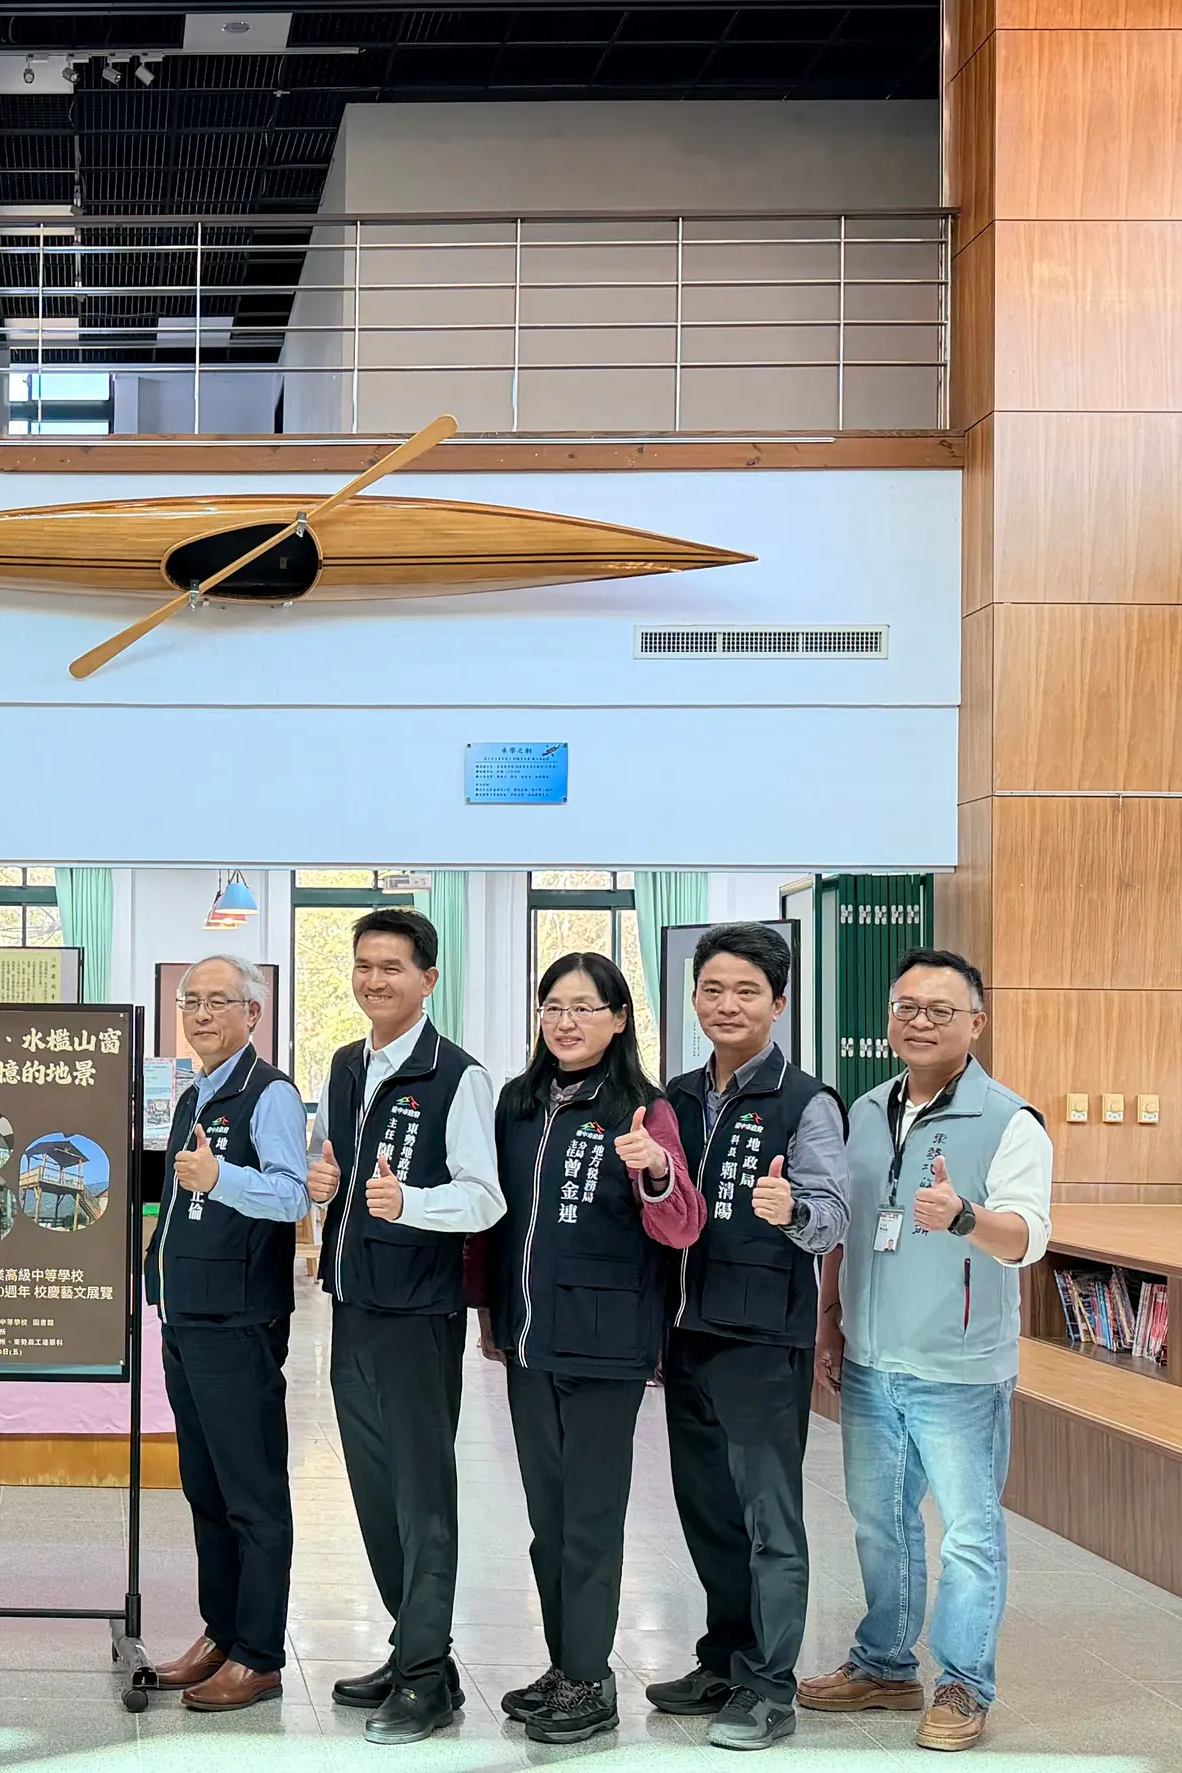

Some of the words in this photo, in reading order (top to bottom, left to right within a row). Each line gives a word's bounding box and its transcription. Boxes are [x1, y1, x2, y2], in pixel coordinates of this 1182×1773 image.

[739, 1137, 761, 1188] 地政局
[33, 1285, 114, 1300] 校慶藝文展覽
